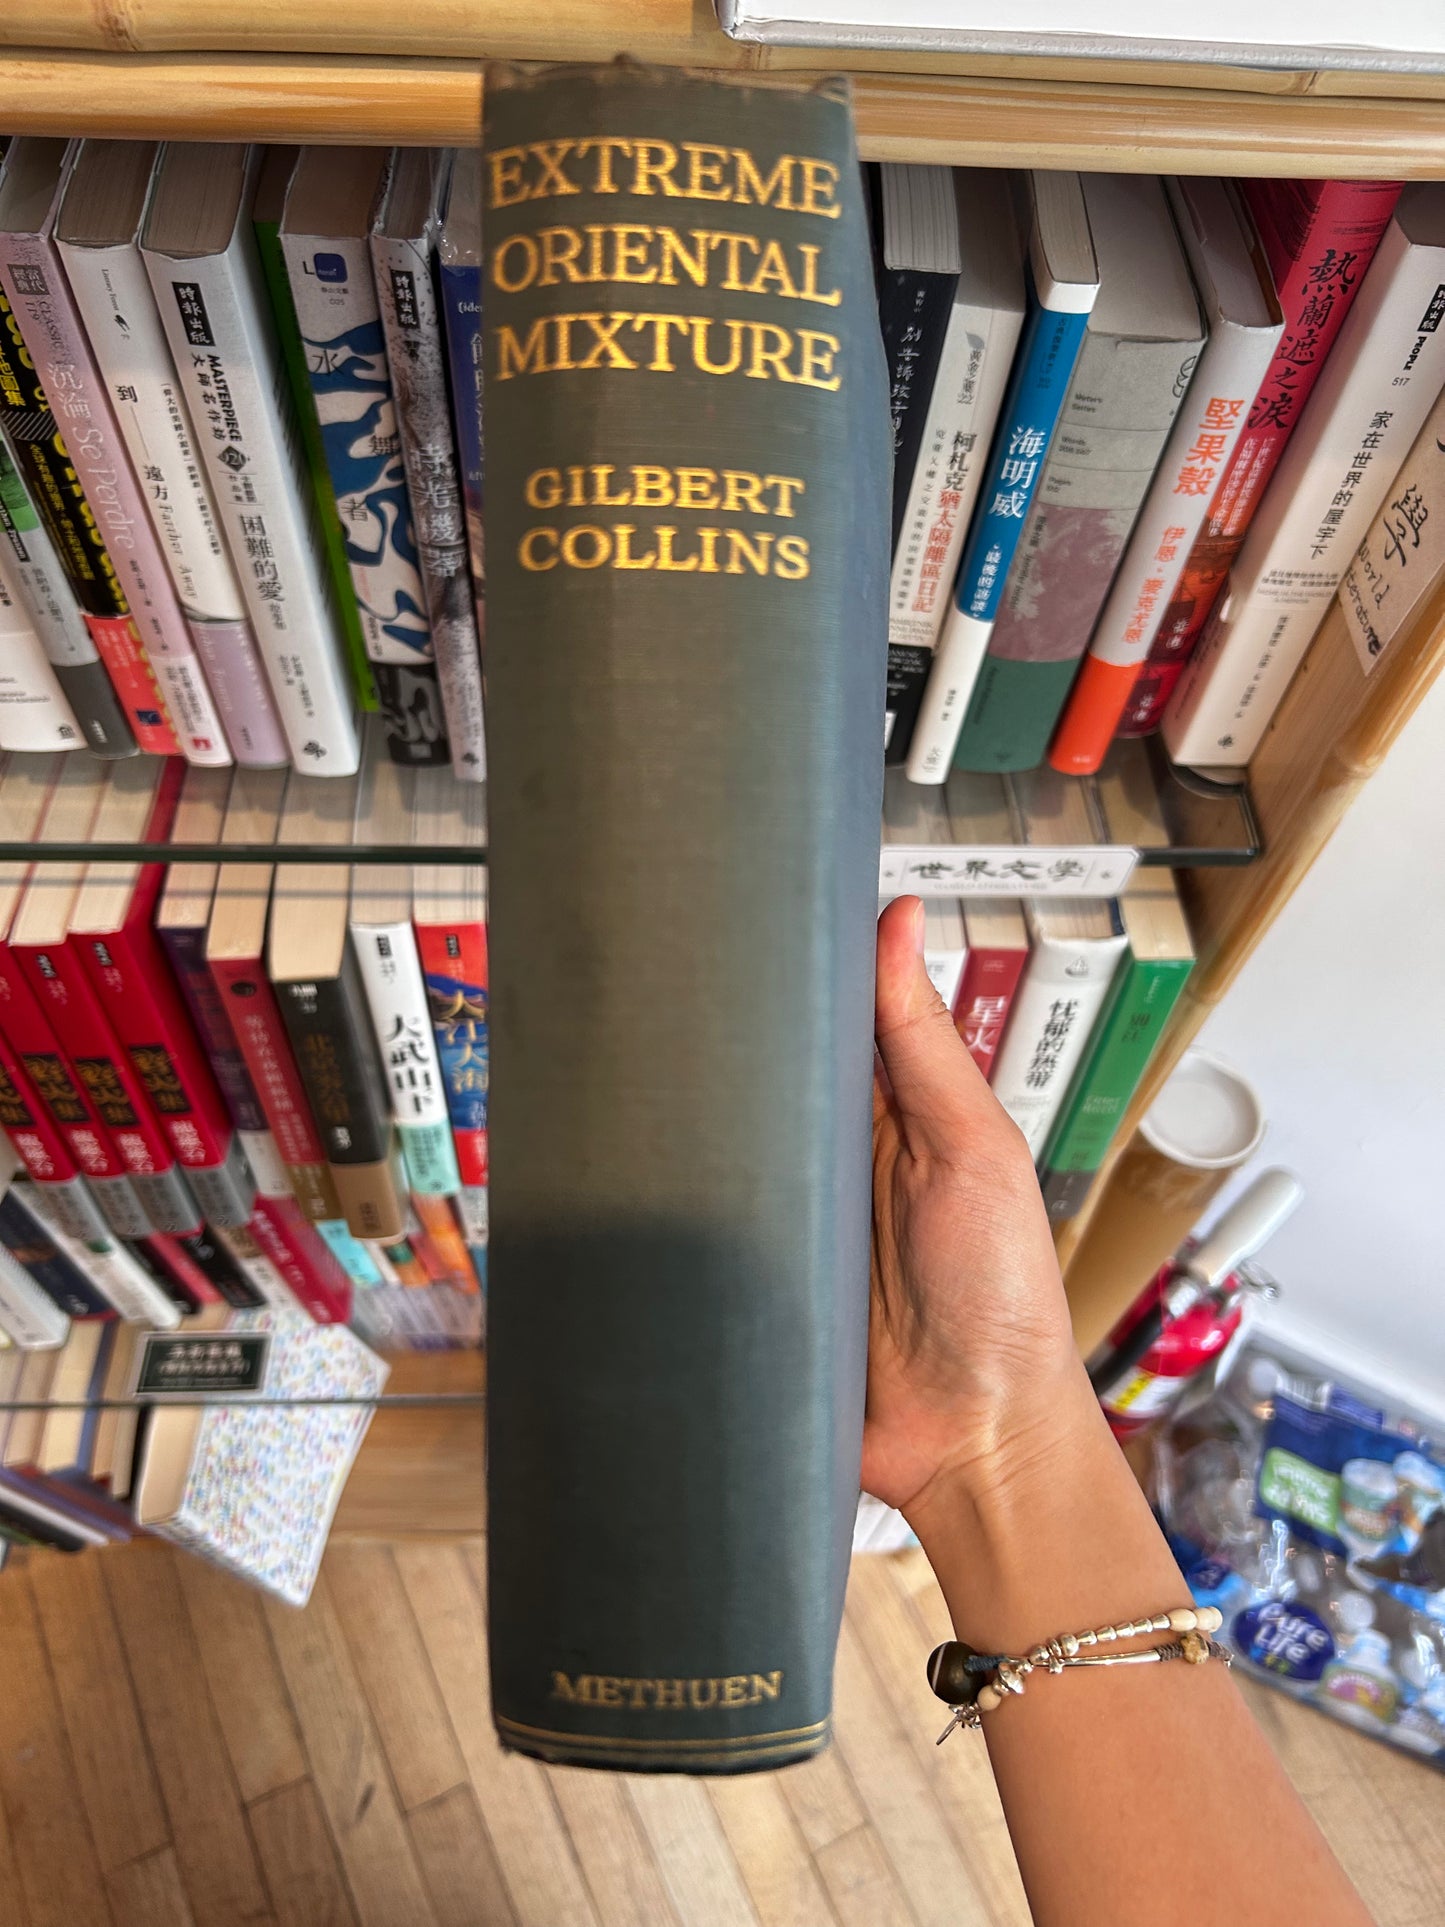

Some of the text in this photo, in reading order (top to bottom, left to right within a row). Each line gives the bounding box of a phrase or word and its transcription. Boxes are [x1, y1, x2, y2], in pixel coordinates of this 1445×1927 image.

[487, 135, 842, 219] EXTREME
[491, 223, 842, 307] ORIENTAL
[39, 301, 65, 350] CLASSIC
[179, 286, 211, 345] 時報出版
[1246, 249, 1357, 430] 熱蘭遮之淚
[495, 311, 842, 392] MIXTURE
[1392, 377, 1411, 387] 517
[1403, 336, 1428, 371] PEOPLE
[191, 353, 227, 442] 大師名作坊
[207, 353, 243, 443] MASTERPIECE
[988, 424, 1047, 520] 海明威
[1172, 397, 1245, 497] 堅果殼
[526, 464, 806, 518] GILBERT
[1310, 411, 1393, 560] 家在世界的屋宇下
[239, 515, 285, 602] 困難的愛
[518, 523, 811, 580] COLLINS
[1356, 536, 1391, 610] World
[909, 858, 1086, 884] 世界文學
[963, 994, 1006, 1055] 星火
[1254, 1622, 1311, 1665] Life
[1256, 1601, 1330, 1651] Pure
[551, 1670, 785, 1711] METHUEN
